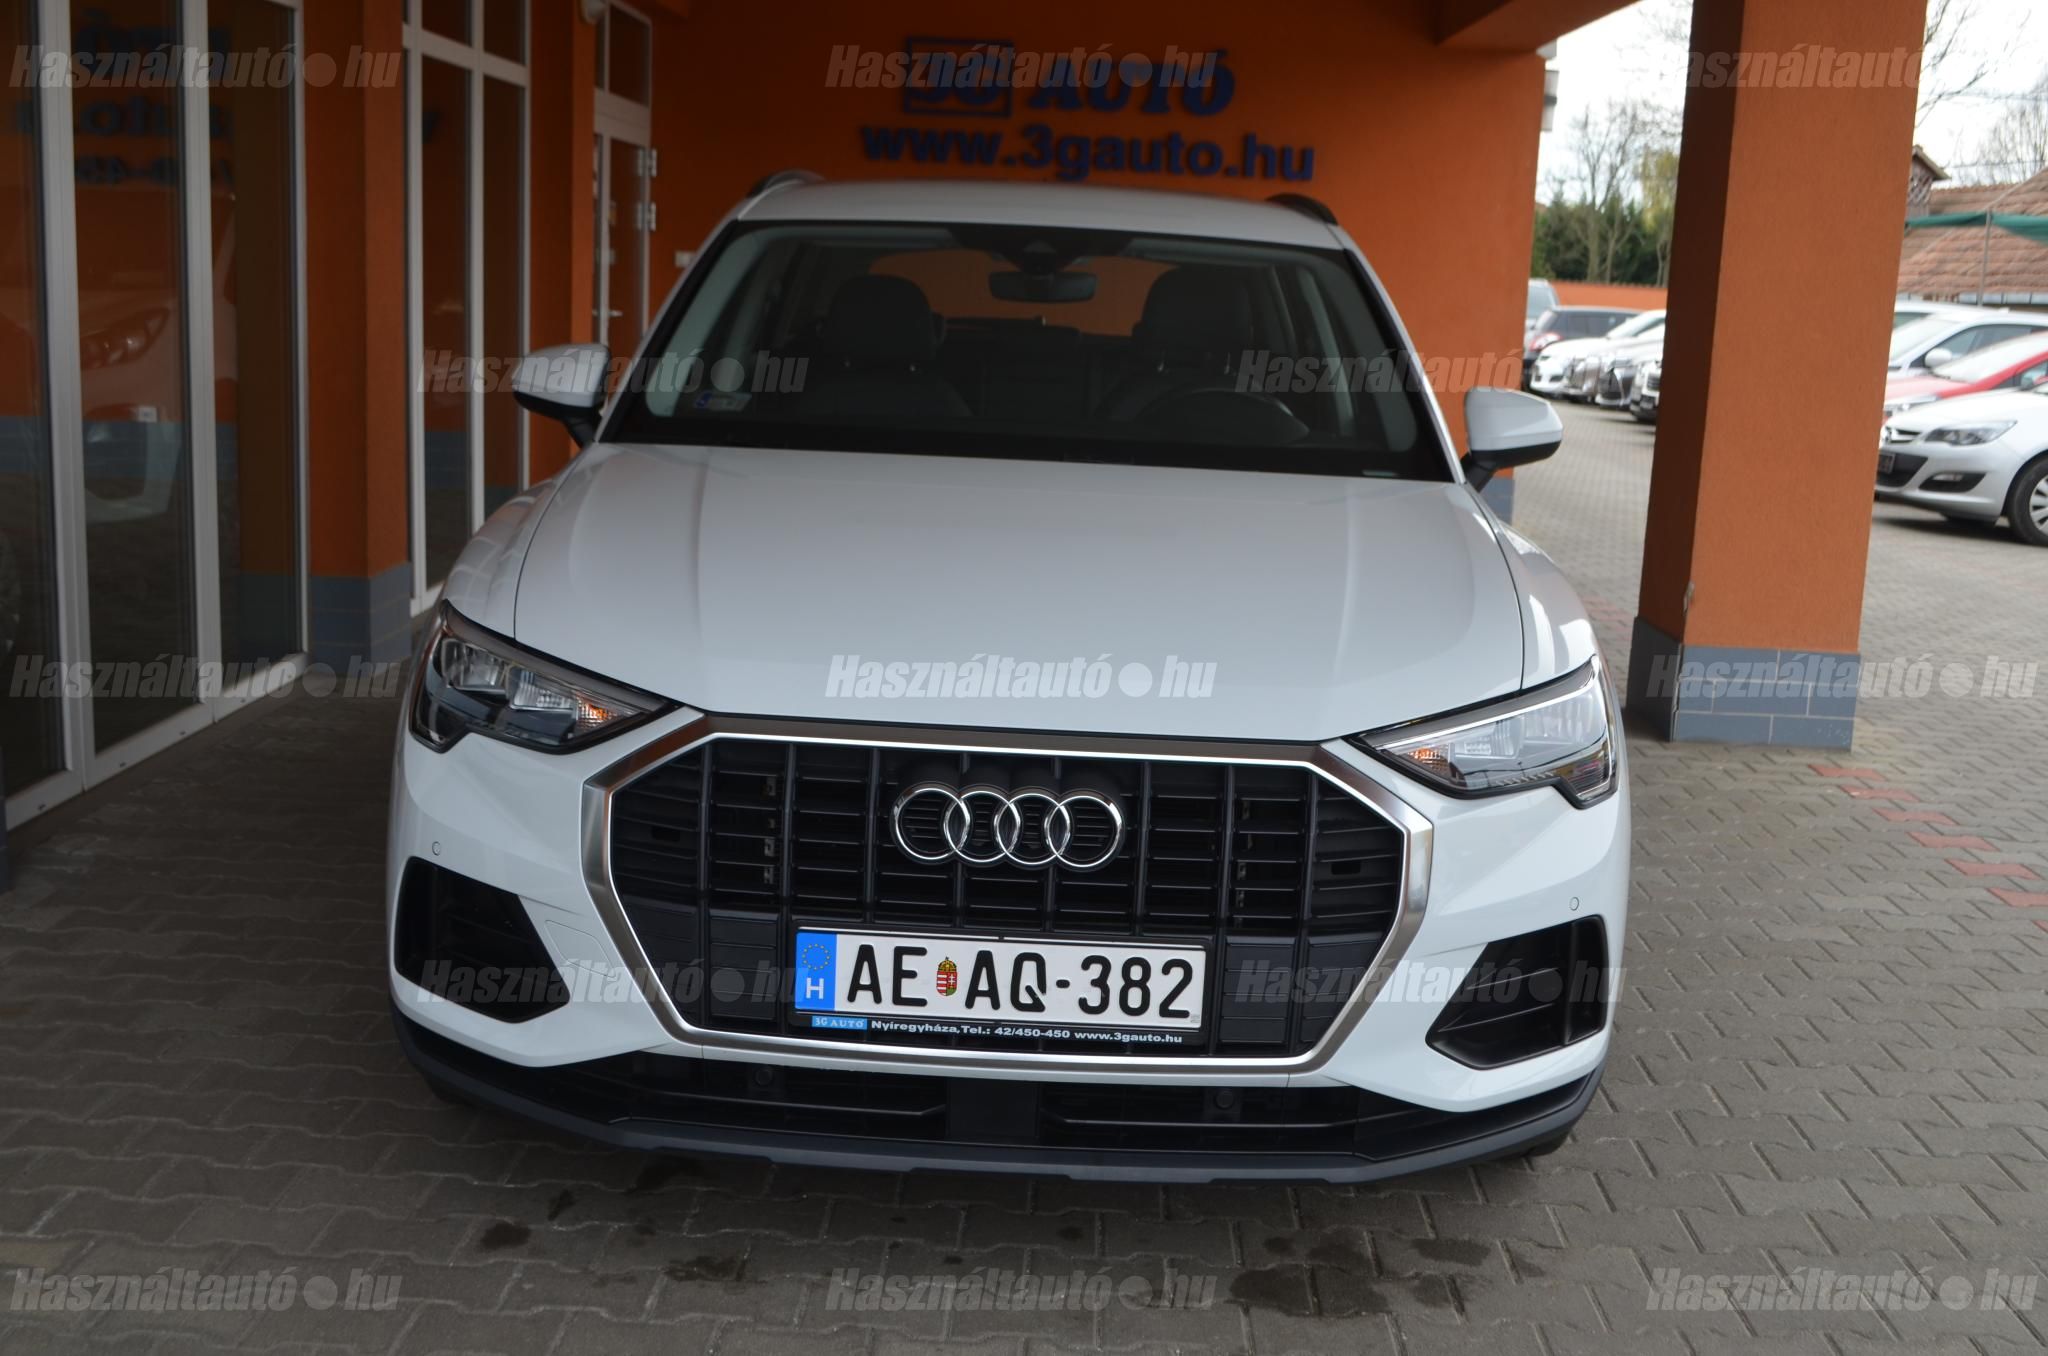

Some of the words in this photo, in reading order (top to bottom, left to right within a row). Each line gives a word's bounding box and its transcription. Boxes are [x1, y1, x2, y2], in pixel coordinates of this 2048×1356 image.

[861, 122, 1315, 182] www.3gauto.hu
[805, 978, 824, 999] H
[847, 944, 928, 1007] AE
[965, 949, 1193, 1018] AQ-382
[994, 1026, 1070, 1039] 42/450-450
[1075, 1031, 1182, 1043] www.3gauto.hu
